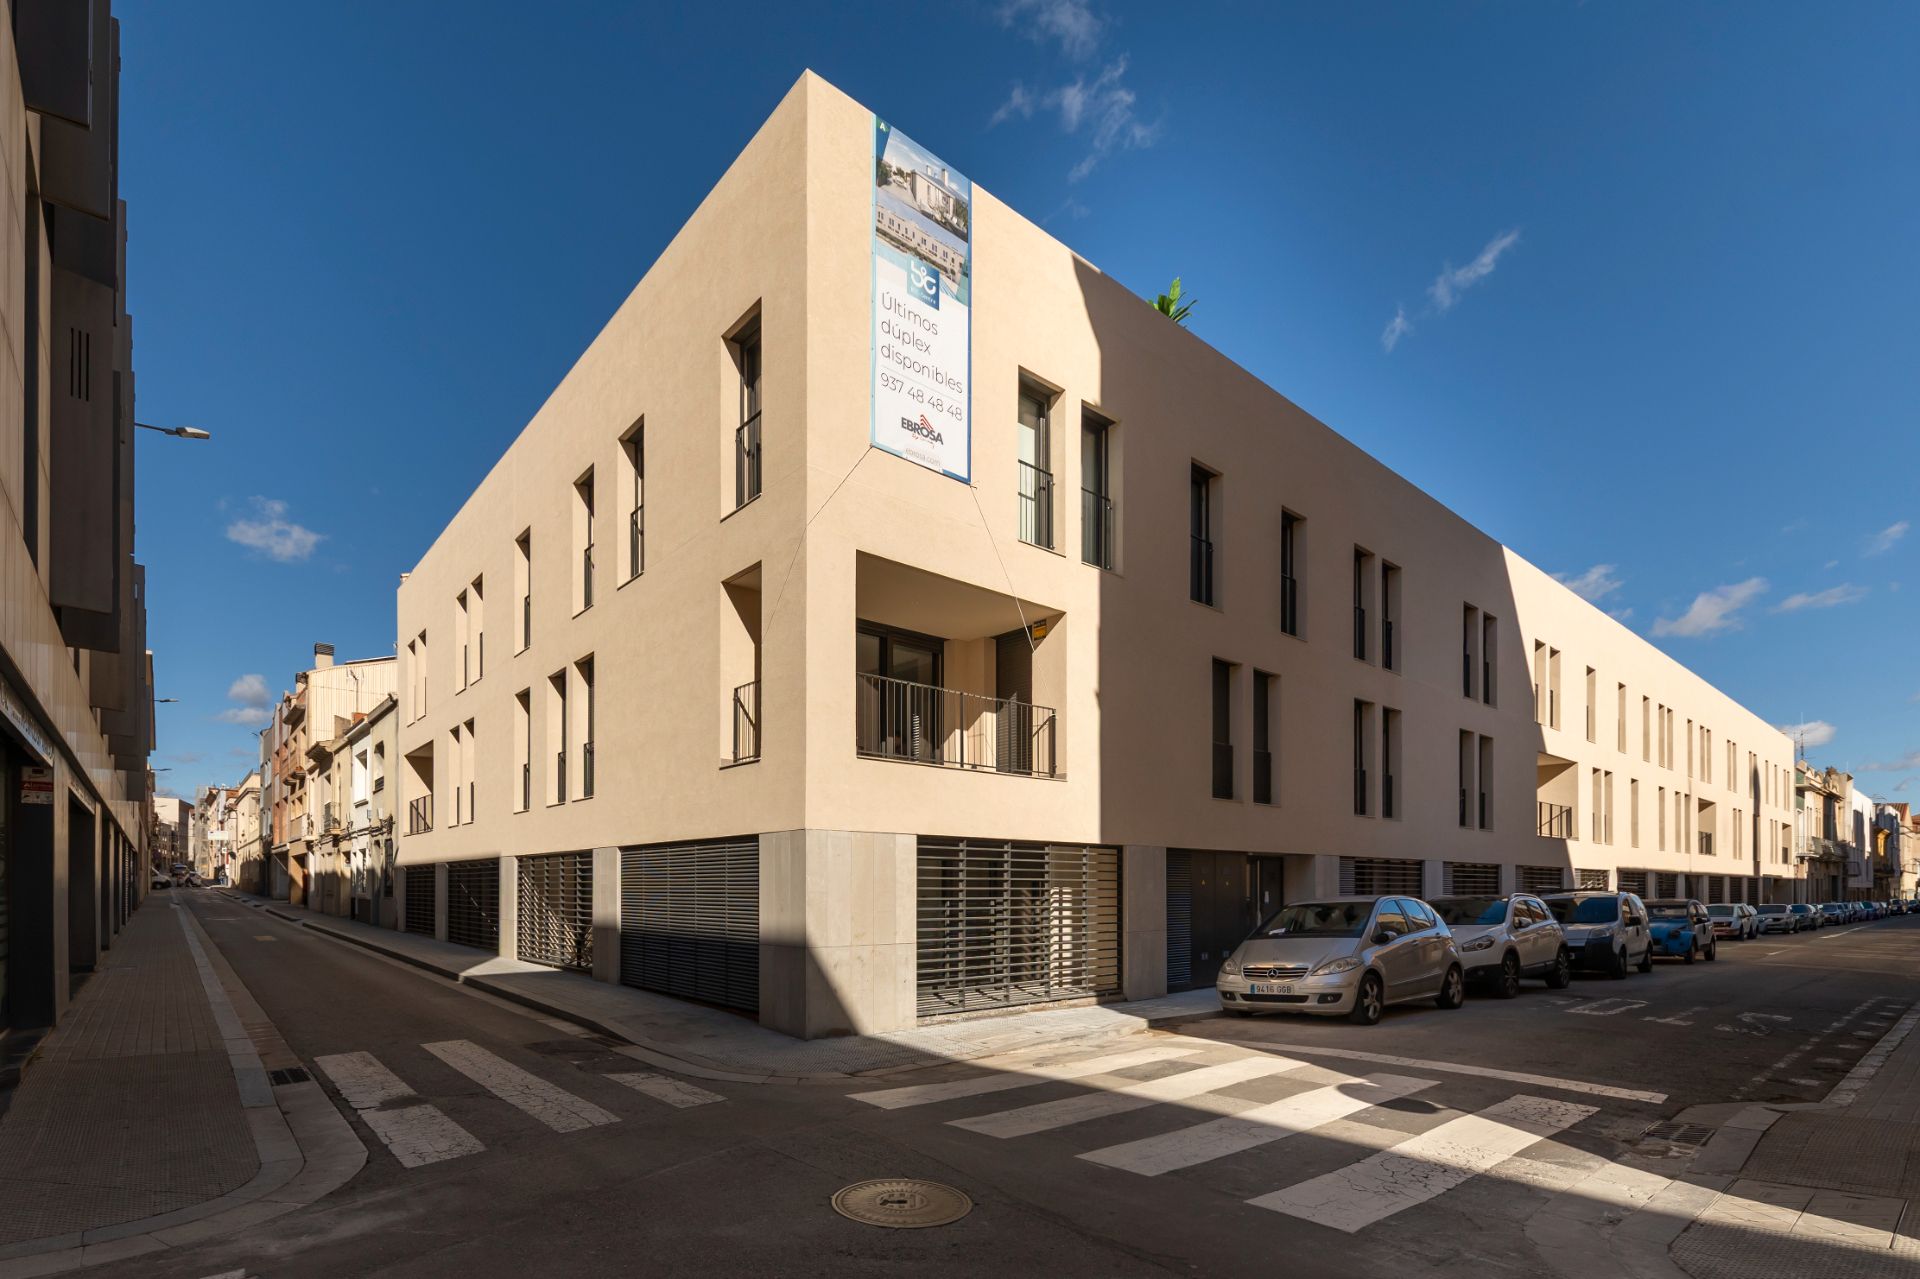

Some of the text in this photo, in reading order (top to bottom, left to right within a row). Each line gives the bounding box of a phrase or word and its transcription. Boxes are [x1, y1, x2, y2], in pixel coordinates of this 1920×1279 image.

[882, 291, 938, 336] Últimos
[881, 319, 931, 356] dúplex
[881, 343, 963, 394] disponibles
[880, 372, 963, 422] 937 48 48 48
[901, 416, 944, 445] EBROSA
[1256, 985, 1292, 994] 9416 GGB
